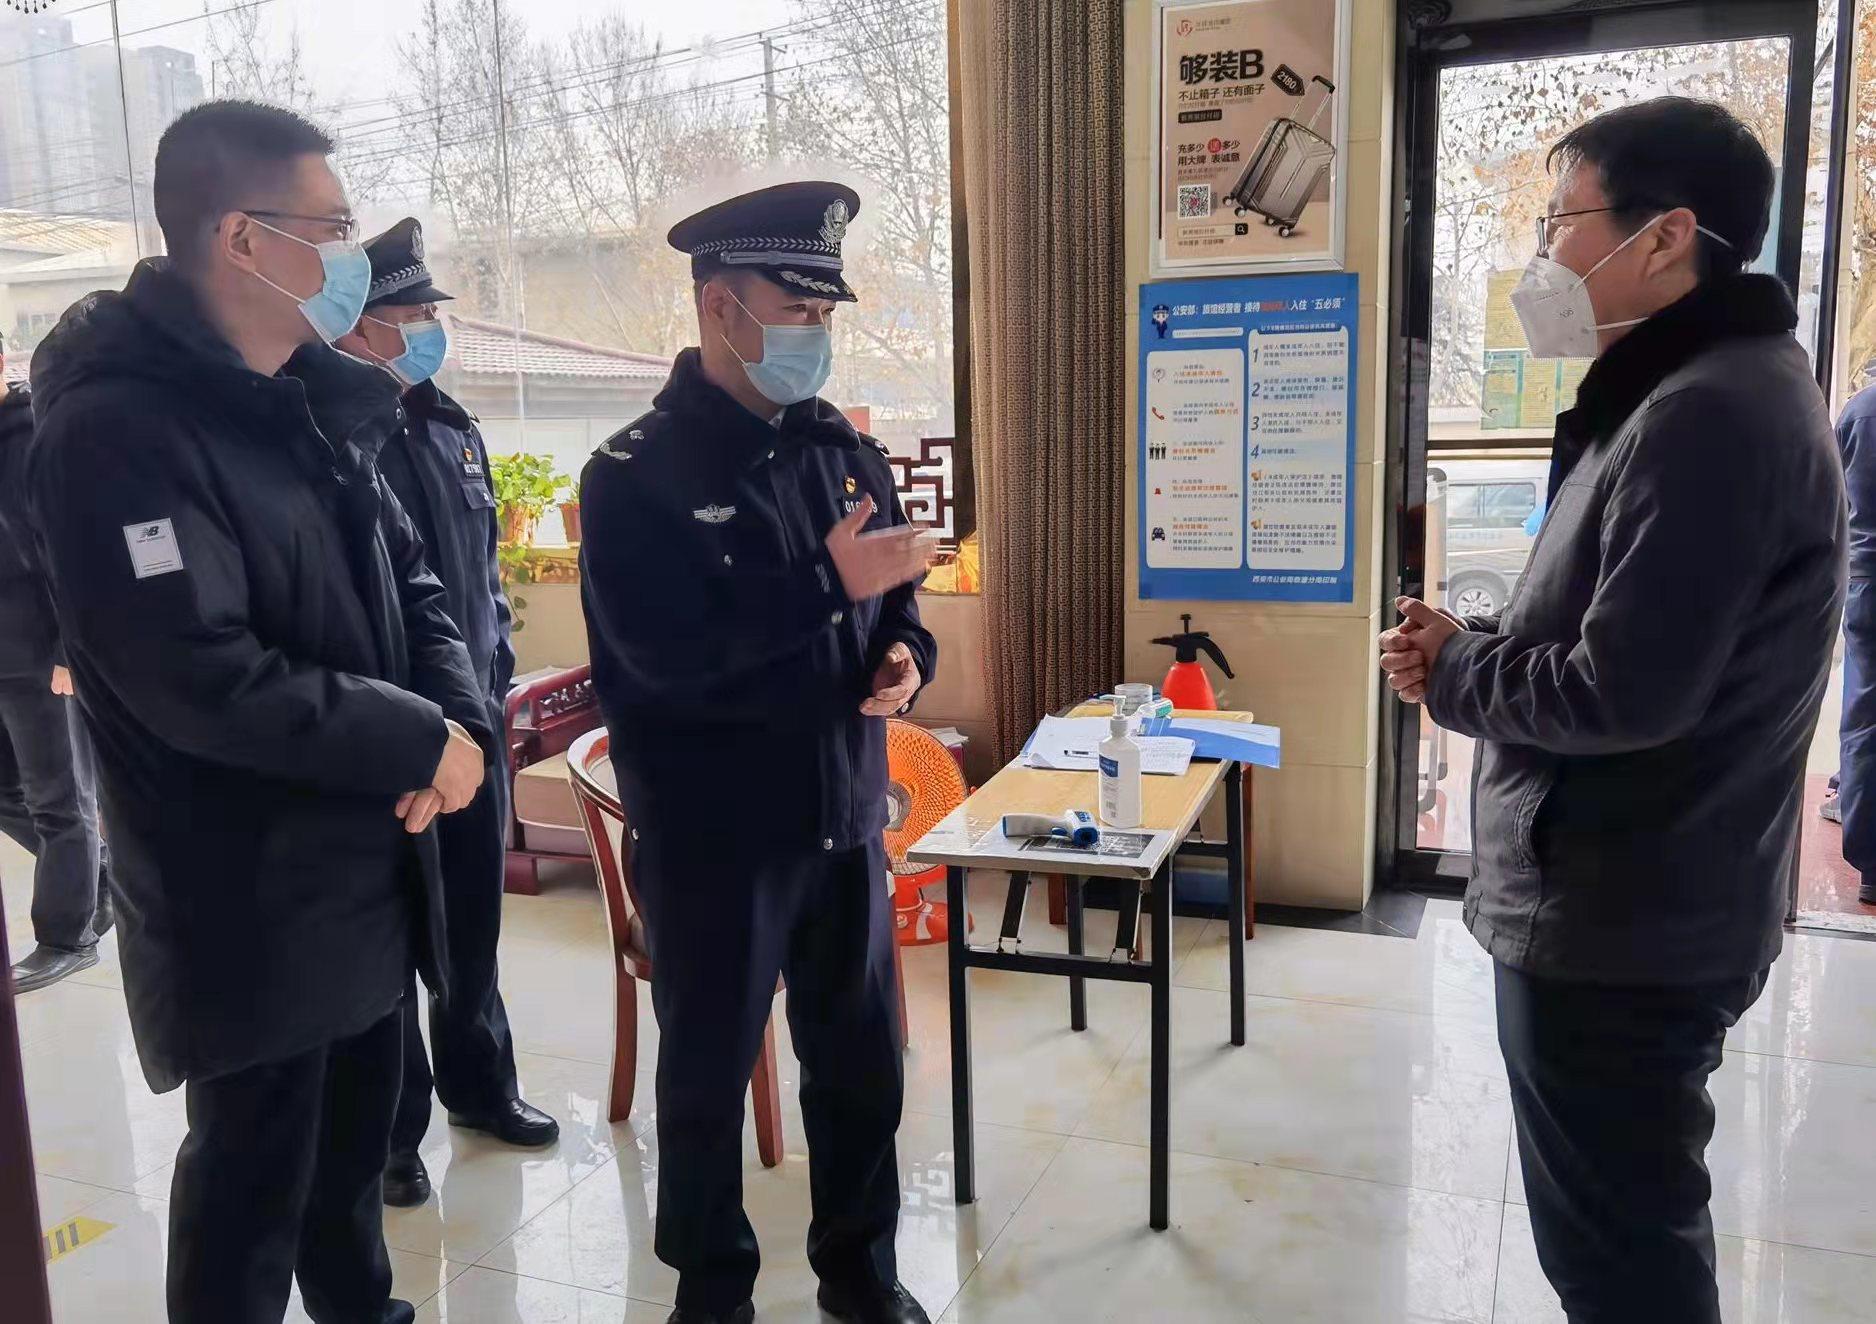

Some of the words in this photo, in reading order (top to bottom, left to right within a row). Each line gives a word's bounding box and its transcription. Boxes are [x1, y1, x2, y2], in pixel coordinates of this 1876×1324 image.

[1179, 49, 1265, 85] 够装B
[1277, 70, 1297, 90] 2180
[1178, 87, 1220, 101] 不止箱子
[1222, 83, 1266, 97] 还有面子
[1177, 154, 1207, 166] 用大牌
[1252, 348, 1259, 363] 1
[1251, 382, 1261, 397] 2
[1250, 415, 1260, 431] 3
[1250, 444, 1260, 459] 4
